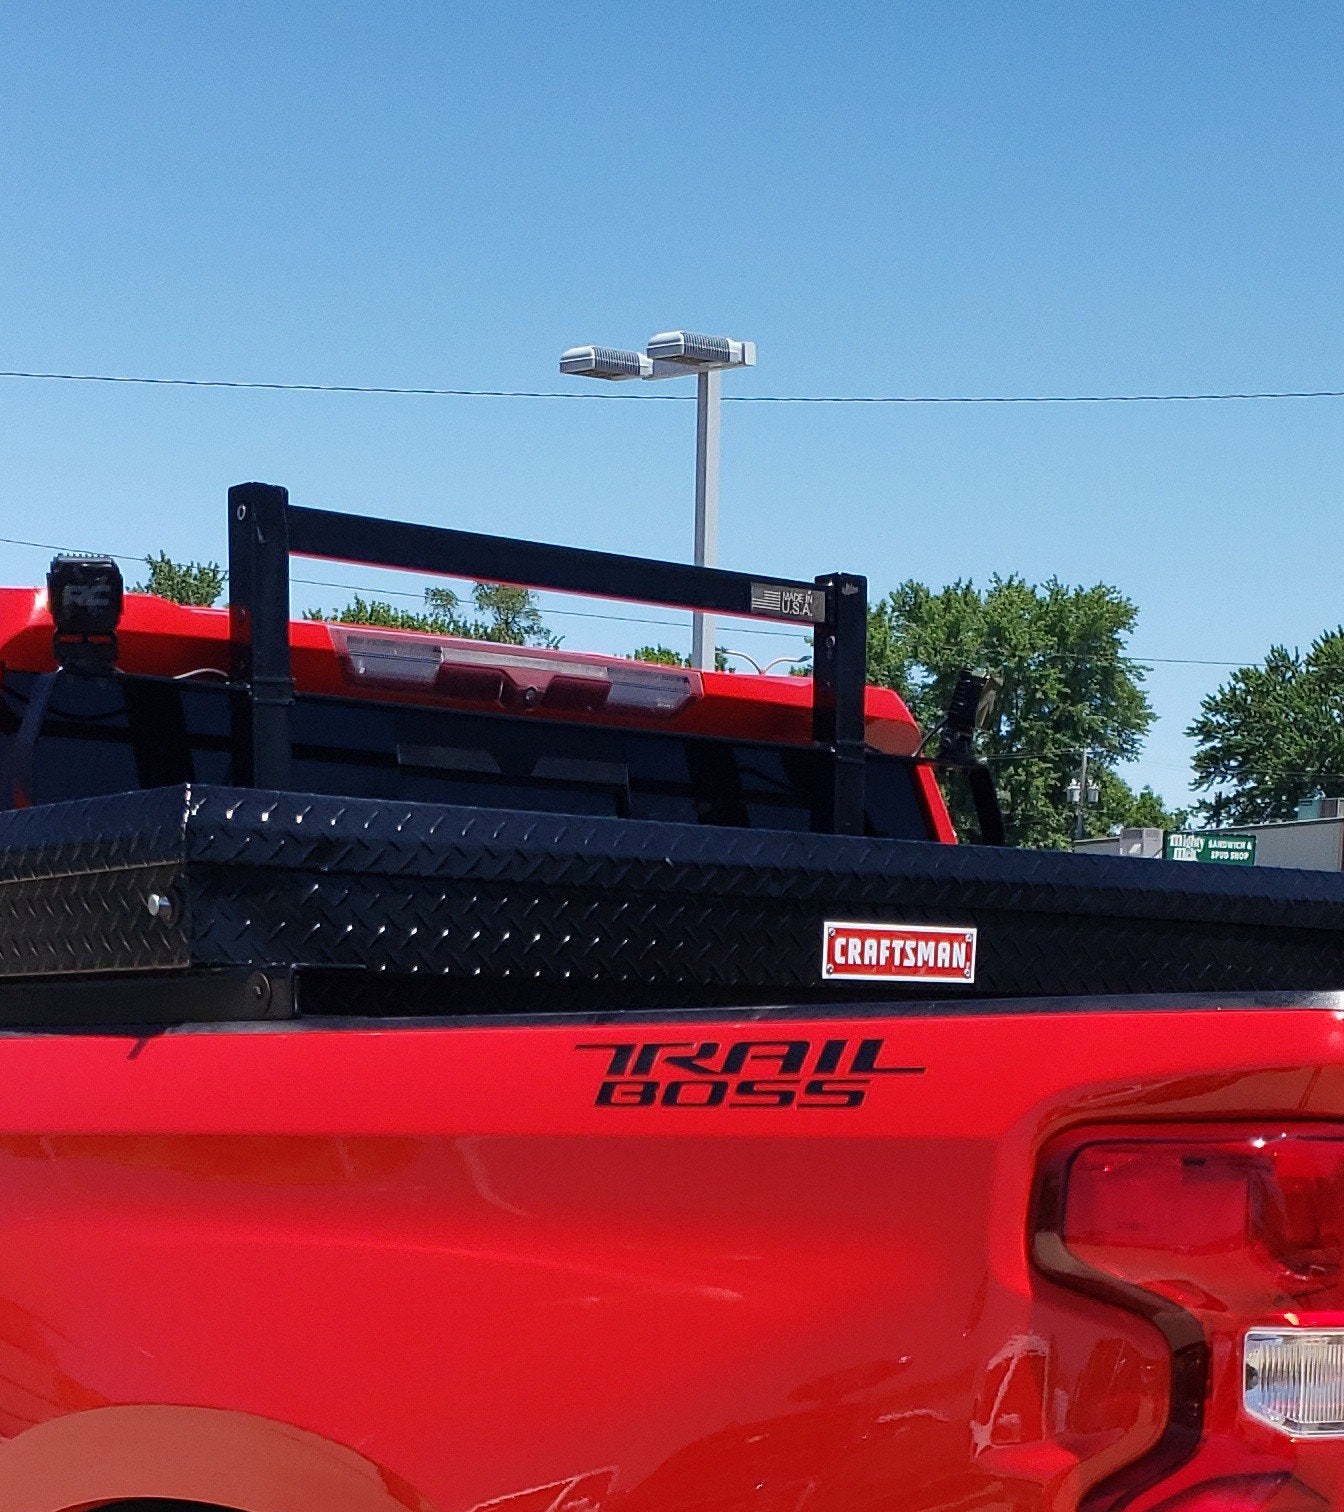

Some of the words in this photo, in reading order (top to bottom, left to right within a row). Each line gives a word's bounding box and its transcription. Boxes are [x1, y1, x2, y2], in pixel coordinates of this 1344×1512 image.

[782, 591, 804, 603] MADE
[805, 592, 813, 604] IN
[782, 600, 813, 616] U.S.A.
[1208, 839, 1246, 849] SANDWICH
[1230, 851, 1249, 860] SHOP
[834, 937, 966, 969] CRAFTSMAN
[574, 1038, 927, 1076] TRAIL
[593, 1079, 873, 1110] BOSS
